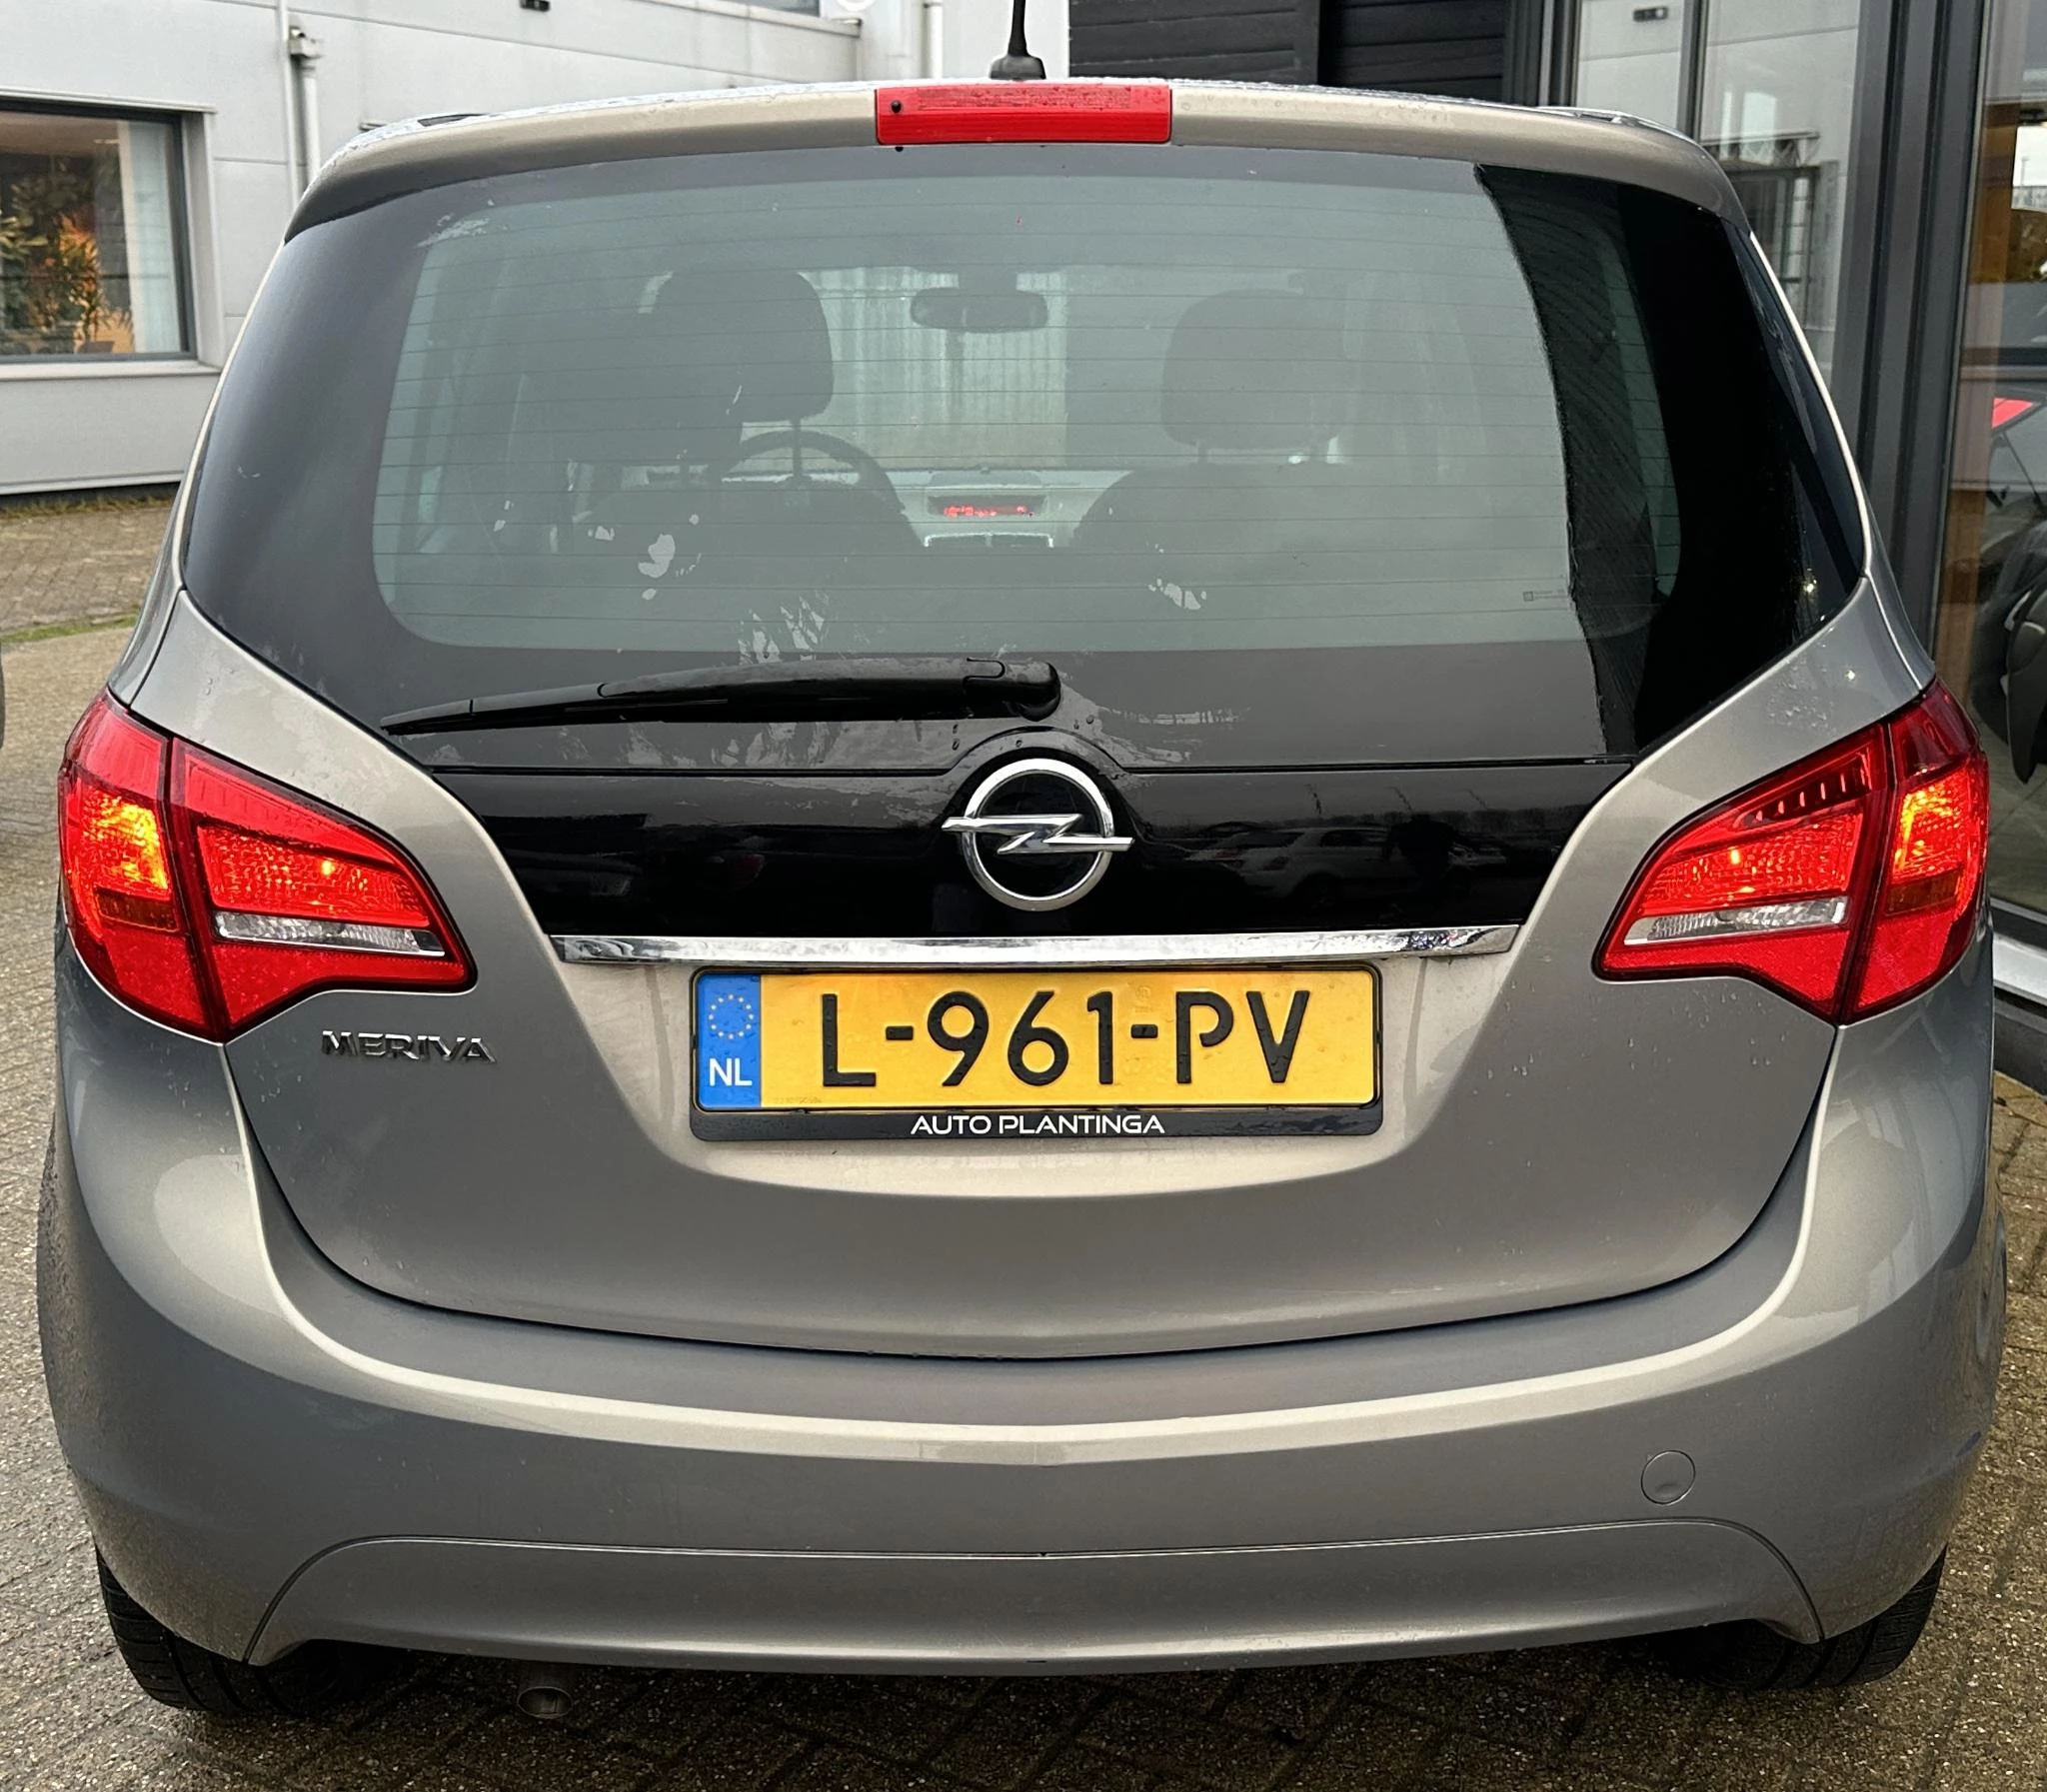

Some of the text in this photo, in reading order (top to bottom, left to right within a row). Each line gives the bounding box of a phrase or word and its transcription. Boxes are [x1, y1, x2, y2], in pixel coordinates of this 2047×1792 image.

[321, 1030, 497, 1062] MERIVA
[822, 990, 1310, 1087] L-961-PV
[710, 1057, 753, 1086] NL
[911, 1114, 1164, 1134] AUTO PLANTINGA
